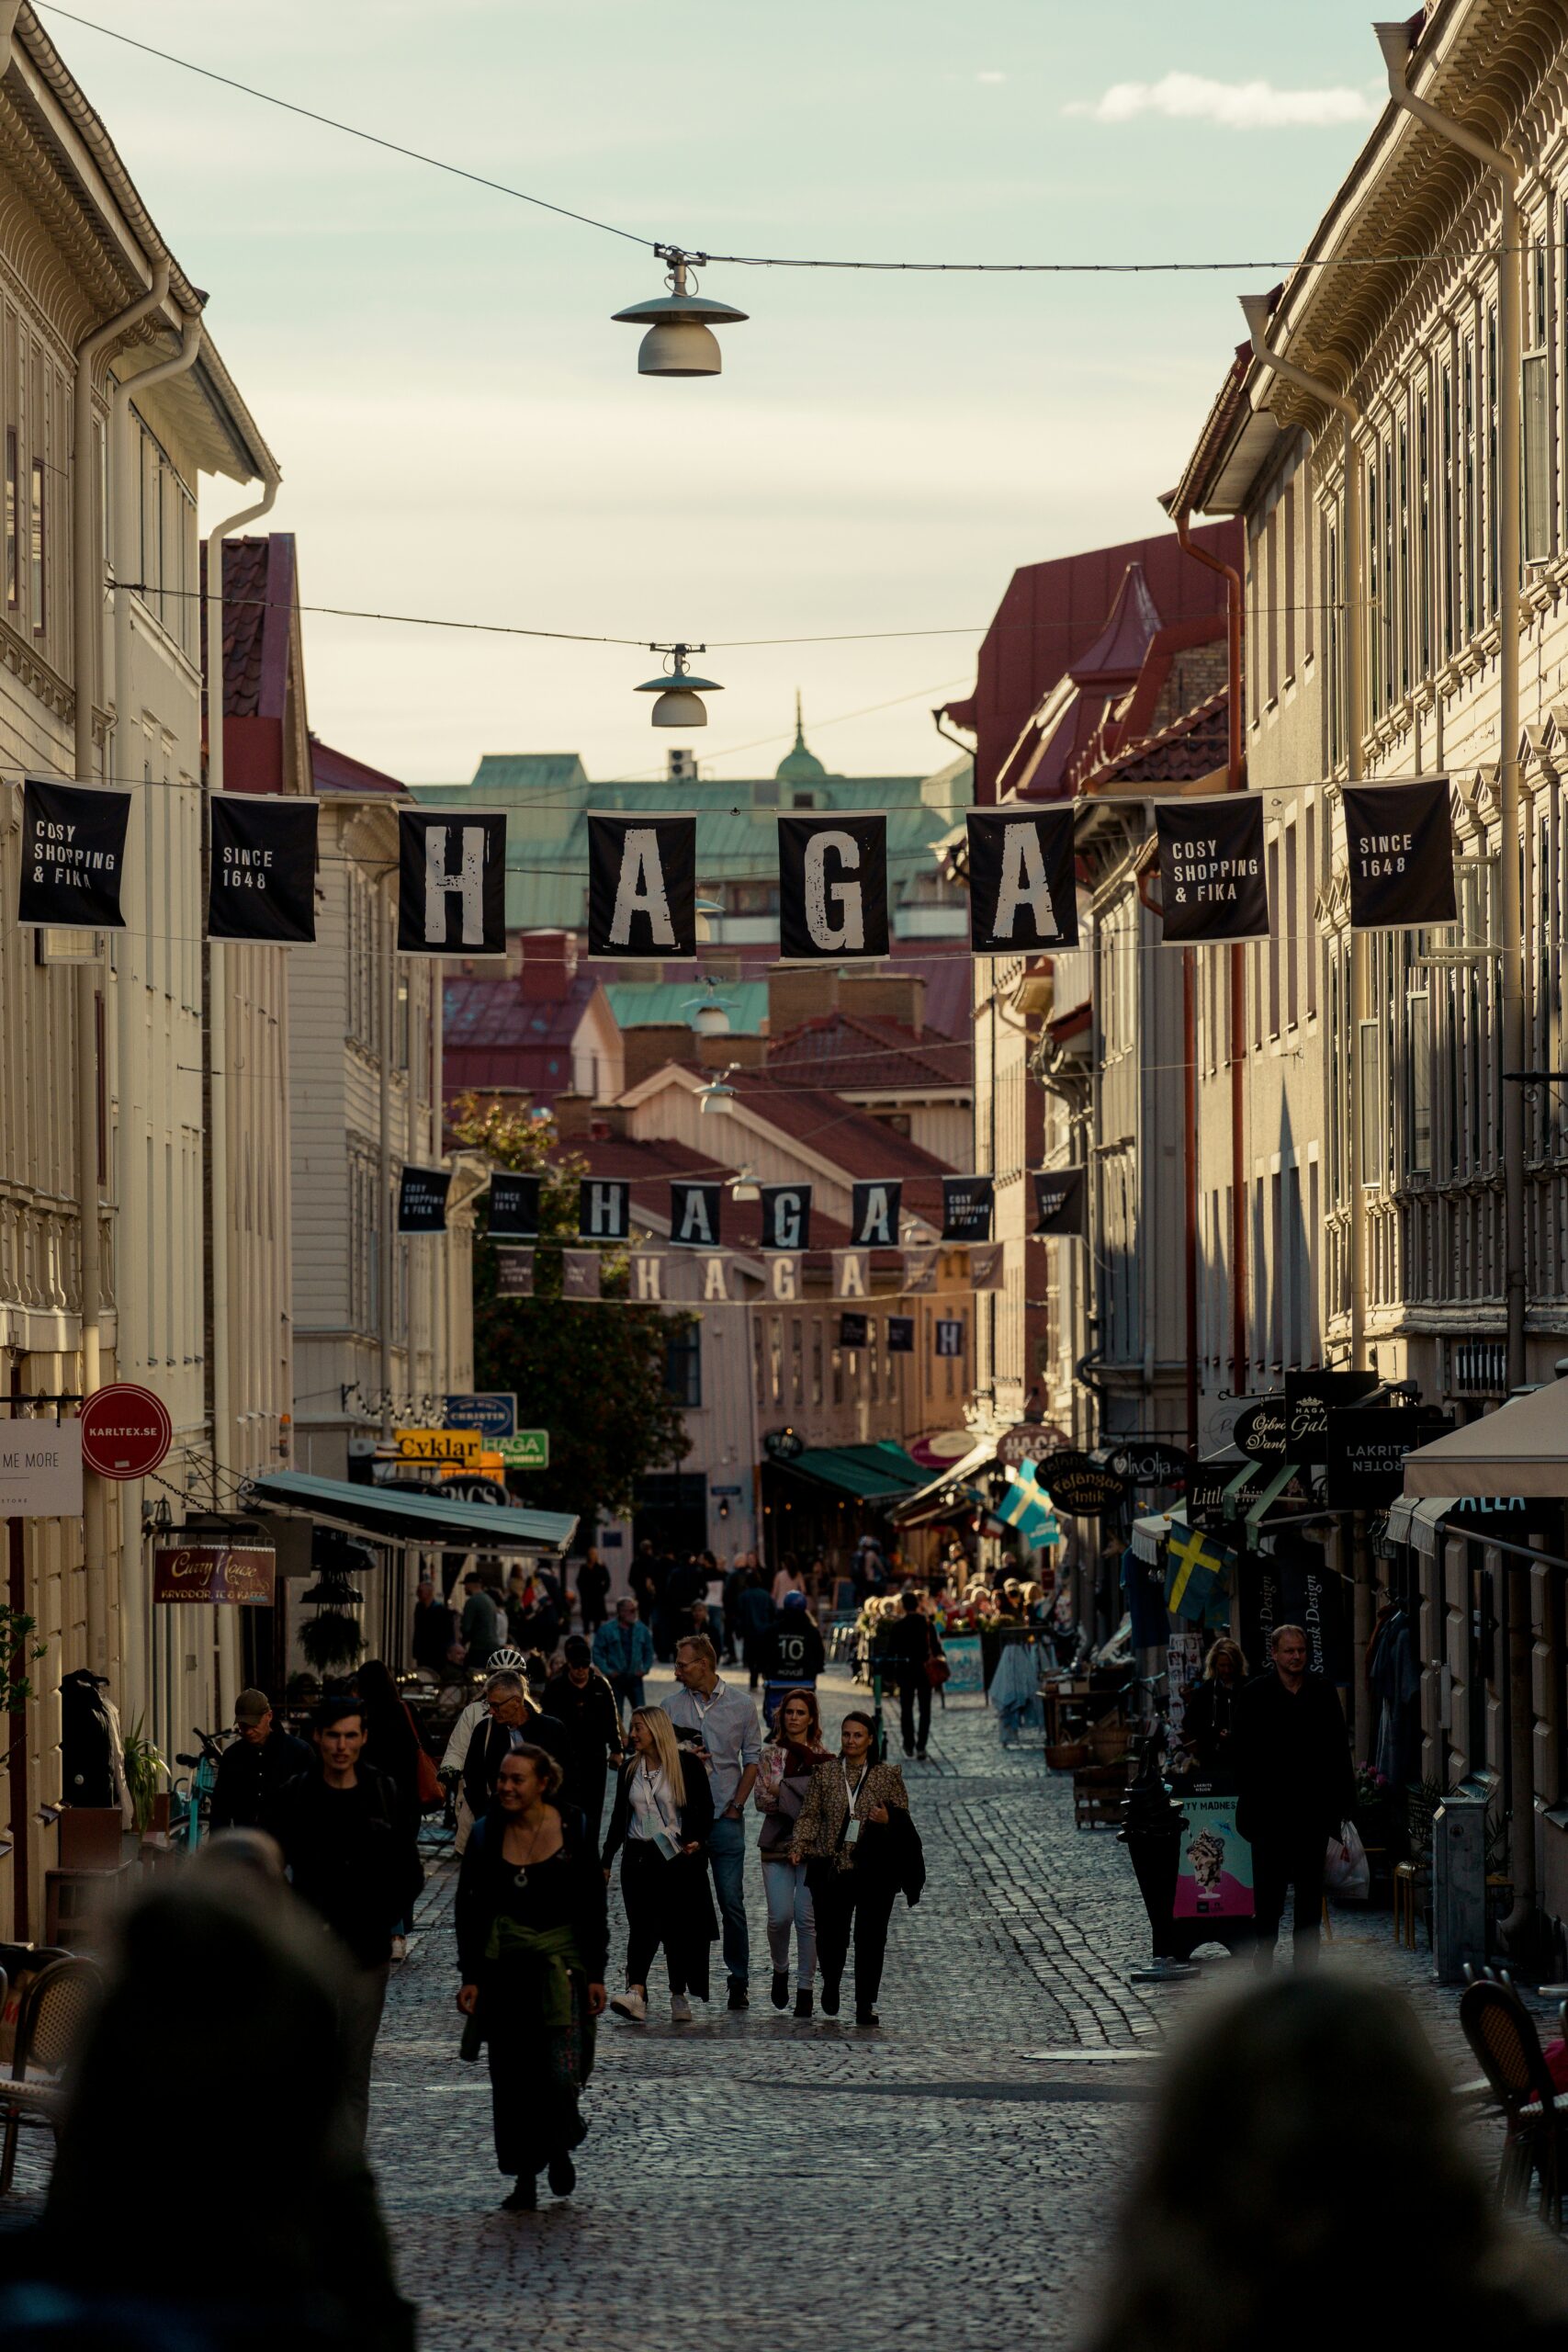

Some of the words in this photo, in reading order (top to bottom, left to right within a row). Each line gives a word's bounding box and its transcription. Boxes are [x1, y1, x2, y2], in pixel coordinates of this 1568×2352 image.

[36, 820, 76, 842] COSY
[1172, 840, 1216, 860] COSY
[1359, 833, 1412, 854] SINCE
[34, 842, 115, 870] SHOPPING
[223, 846, 273, 867] SINCE
[33, 867, 44, 883] &
[55, 868, 92, 888] FIKA
[1175, 860, 1258, 882] SHOPPING
[1360, 857, 1405, 877] 1648
[223, 869, 266, 889] 1648
[425, 826, 483, 944] H
[609, 829, 676, 944] A
[992, 822, 1058, 938] A
[805, 831, 864, 949] G
[1176, 887, 1187, 903] &
[1197, 884, 1237, 902] FIKA
[591, 1183, 621, 1234] H
[680, 1190, 712, 1241] A
[860, 1187, 891, 1242] A
[774, 1192, 801, 1247] G
[89, 1427, 158, 1437] KARLTEX.SE
[483, 1437, 540, 1453] HAGA
[1346, 1444, 1411, 1456] LAKRITS
[3, 1453, 20, 1468] ME
[26, 1452, 60, 1467] MORE
[1192, 1485, 1224, 1505] Littl
[171, 1551, 214, 1587] Curry
[1304, 1575, 1323, 1623] Design
[778, 1639, 805, 1660] 10
[1201, 1801, 1237, 1811] MADNES
